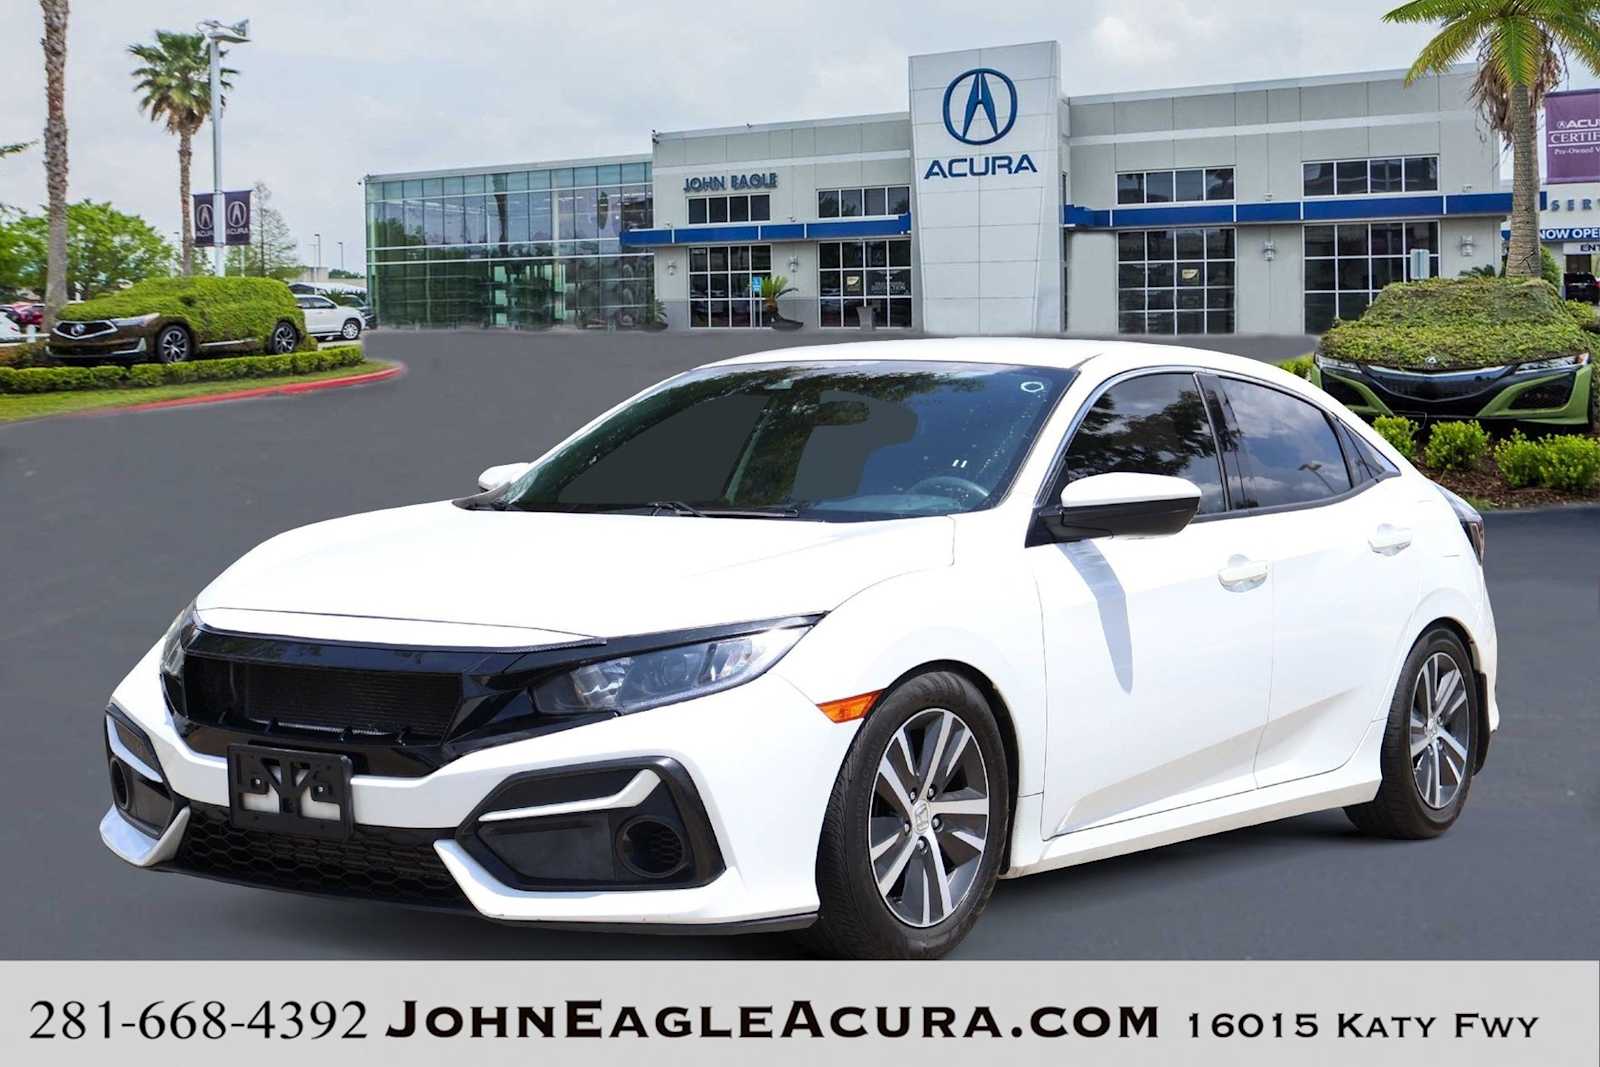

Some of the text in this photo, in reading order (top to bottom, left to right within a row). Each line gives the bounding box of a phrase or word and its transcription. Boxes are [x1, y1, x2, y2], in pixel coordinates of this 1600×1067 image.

[1567, 119, 1600, 129] ACU
[924, 154, 1037, 180] ACURA
[683, 172, 777, 192] JOHN EAGLE
[1539, 228, 1600, 240] NOW OPE
